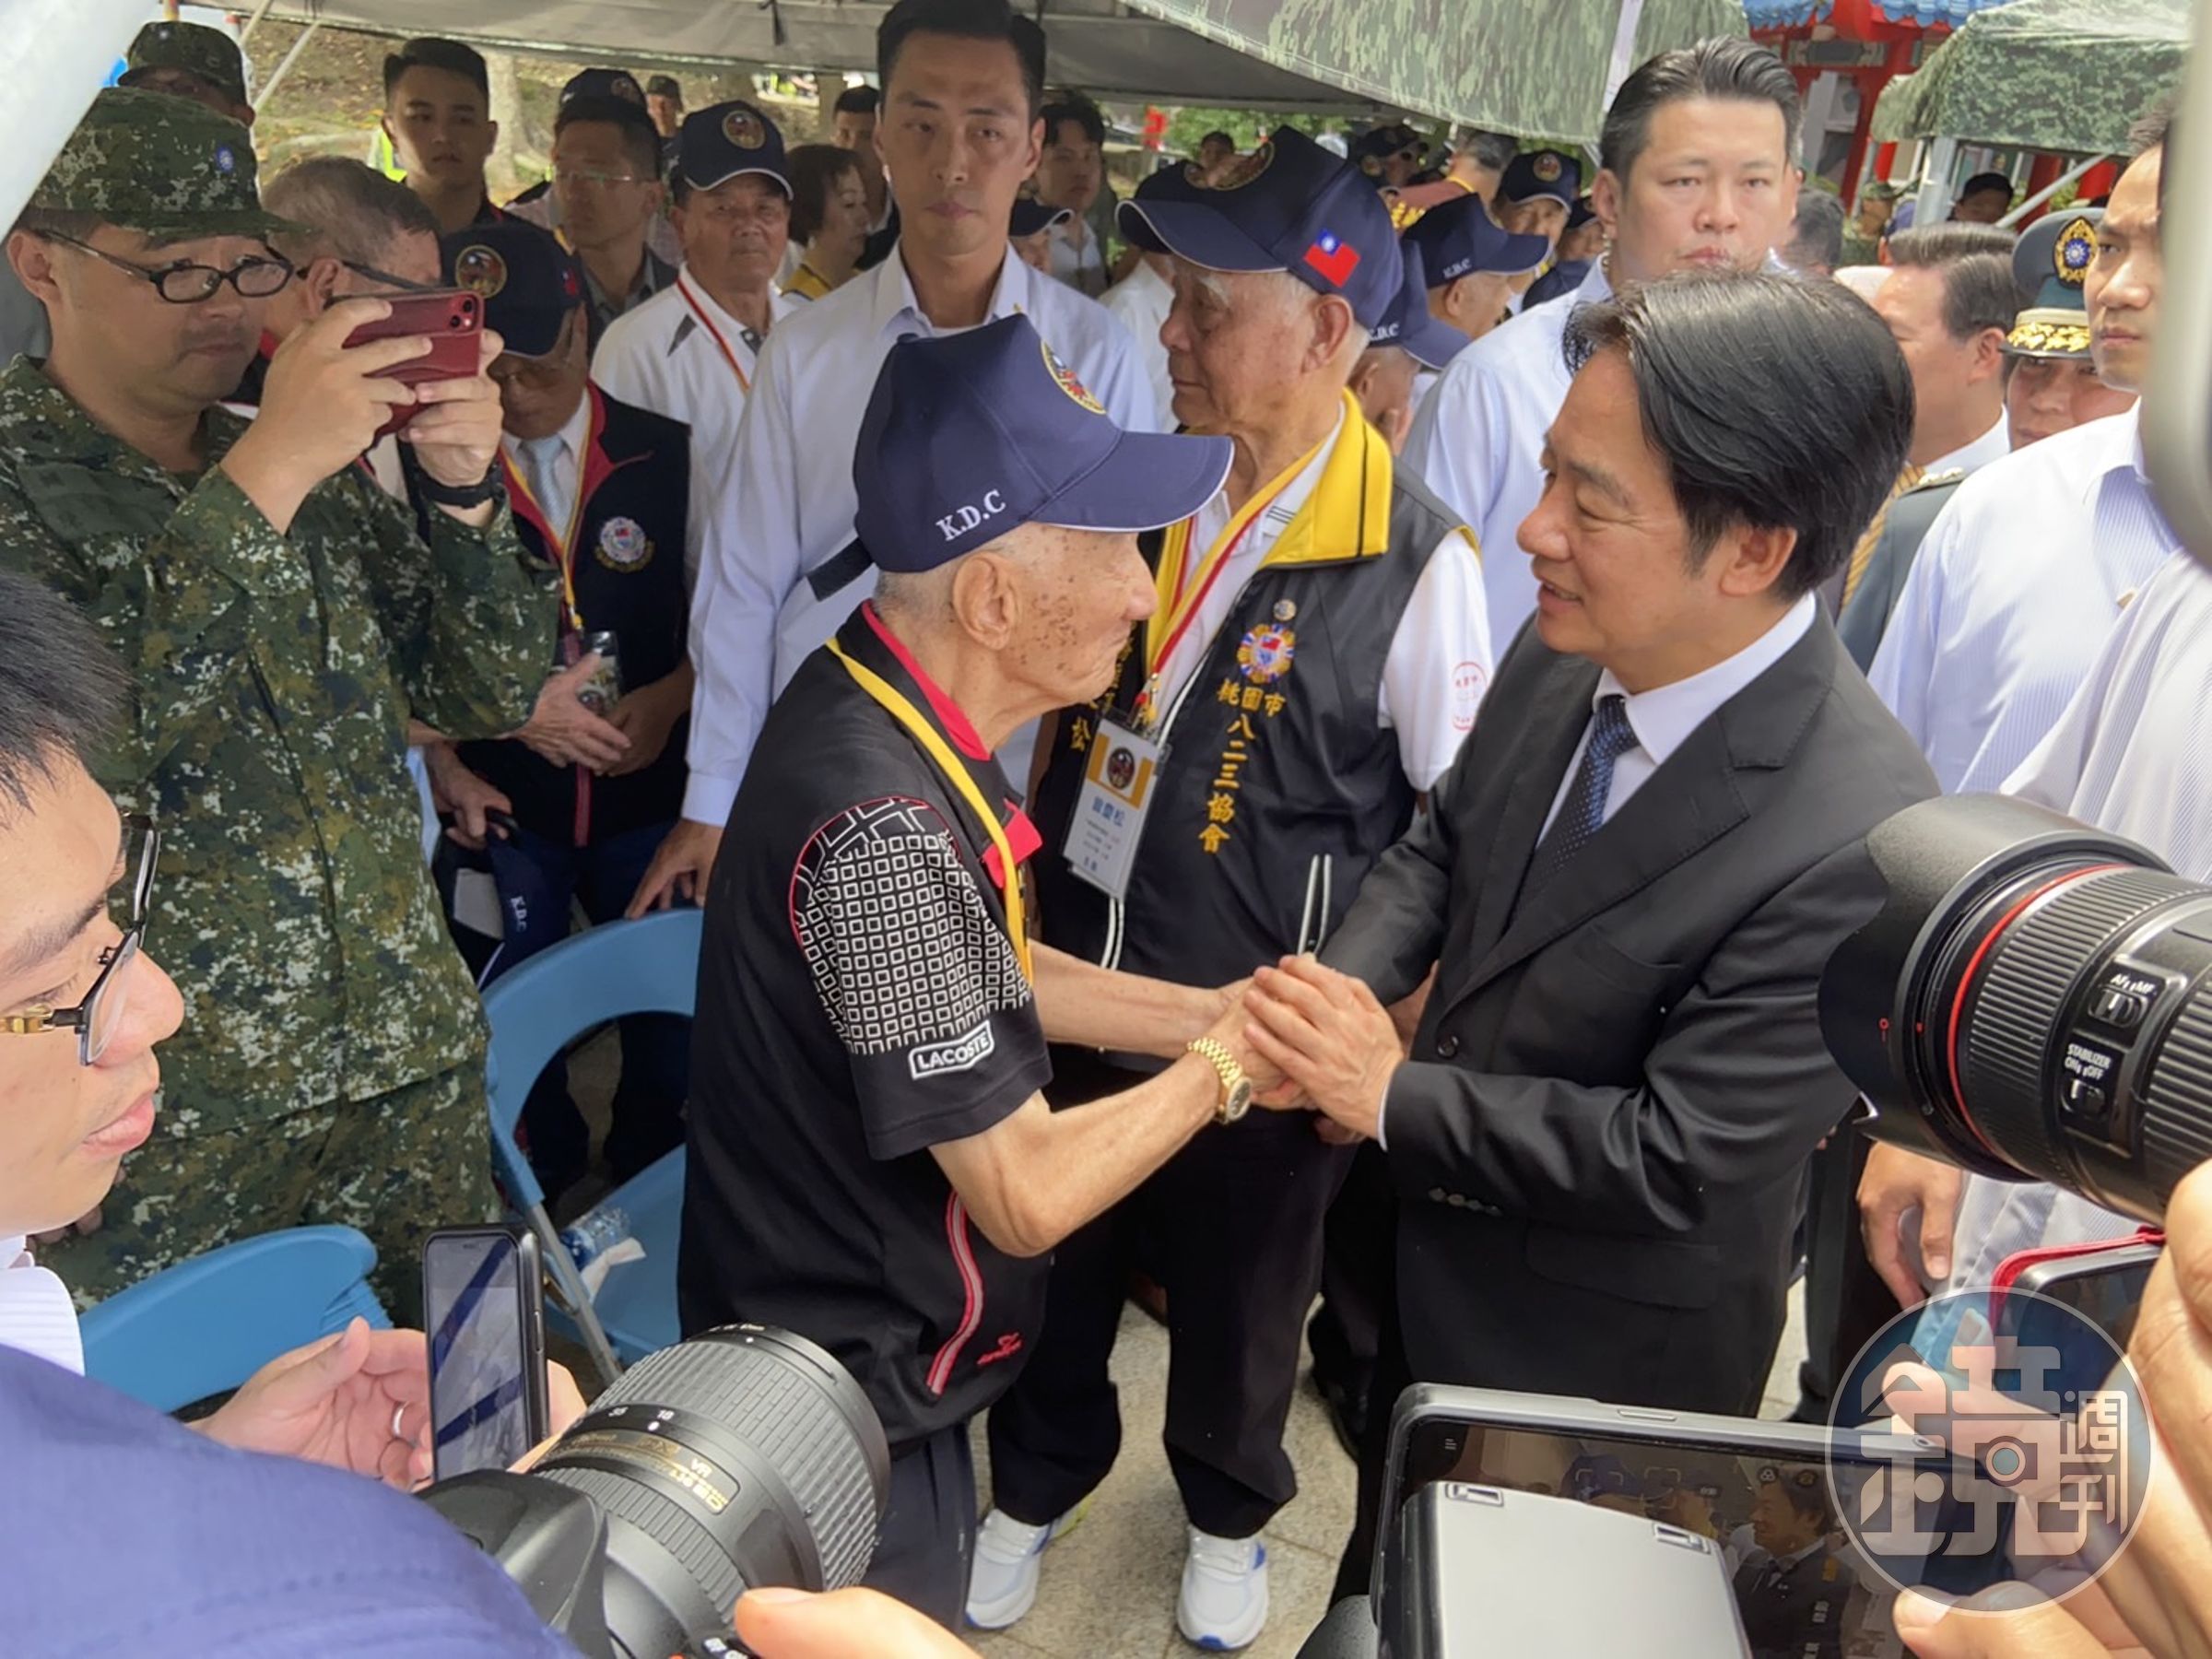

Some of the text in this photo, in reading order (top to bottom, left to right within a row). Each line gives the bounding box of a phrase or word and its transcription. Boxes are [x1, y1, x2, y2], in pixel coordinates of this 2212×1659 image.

[935, 488, 1006, 541] K.D.C
[1218, 677, 1286, 717] 桃園市
[917, 1031, 989, 1069] LACOSTE
[2067, 1042, 2111, 1069] STABILIZER
